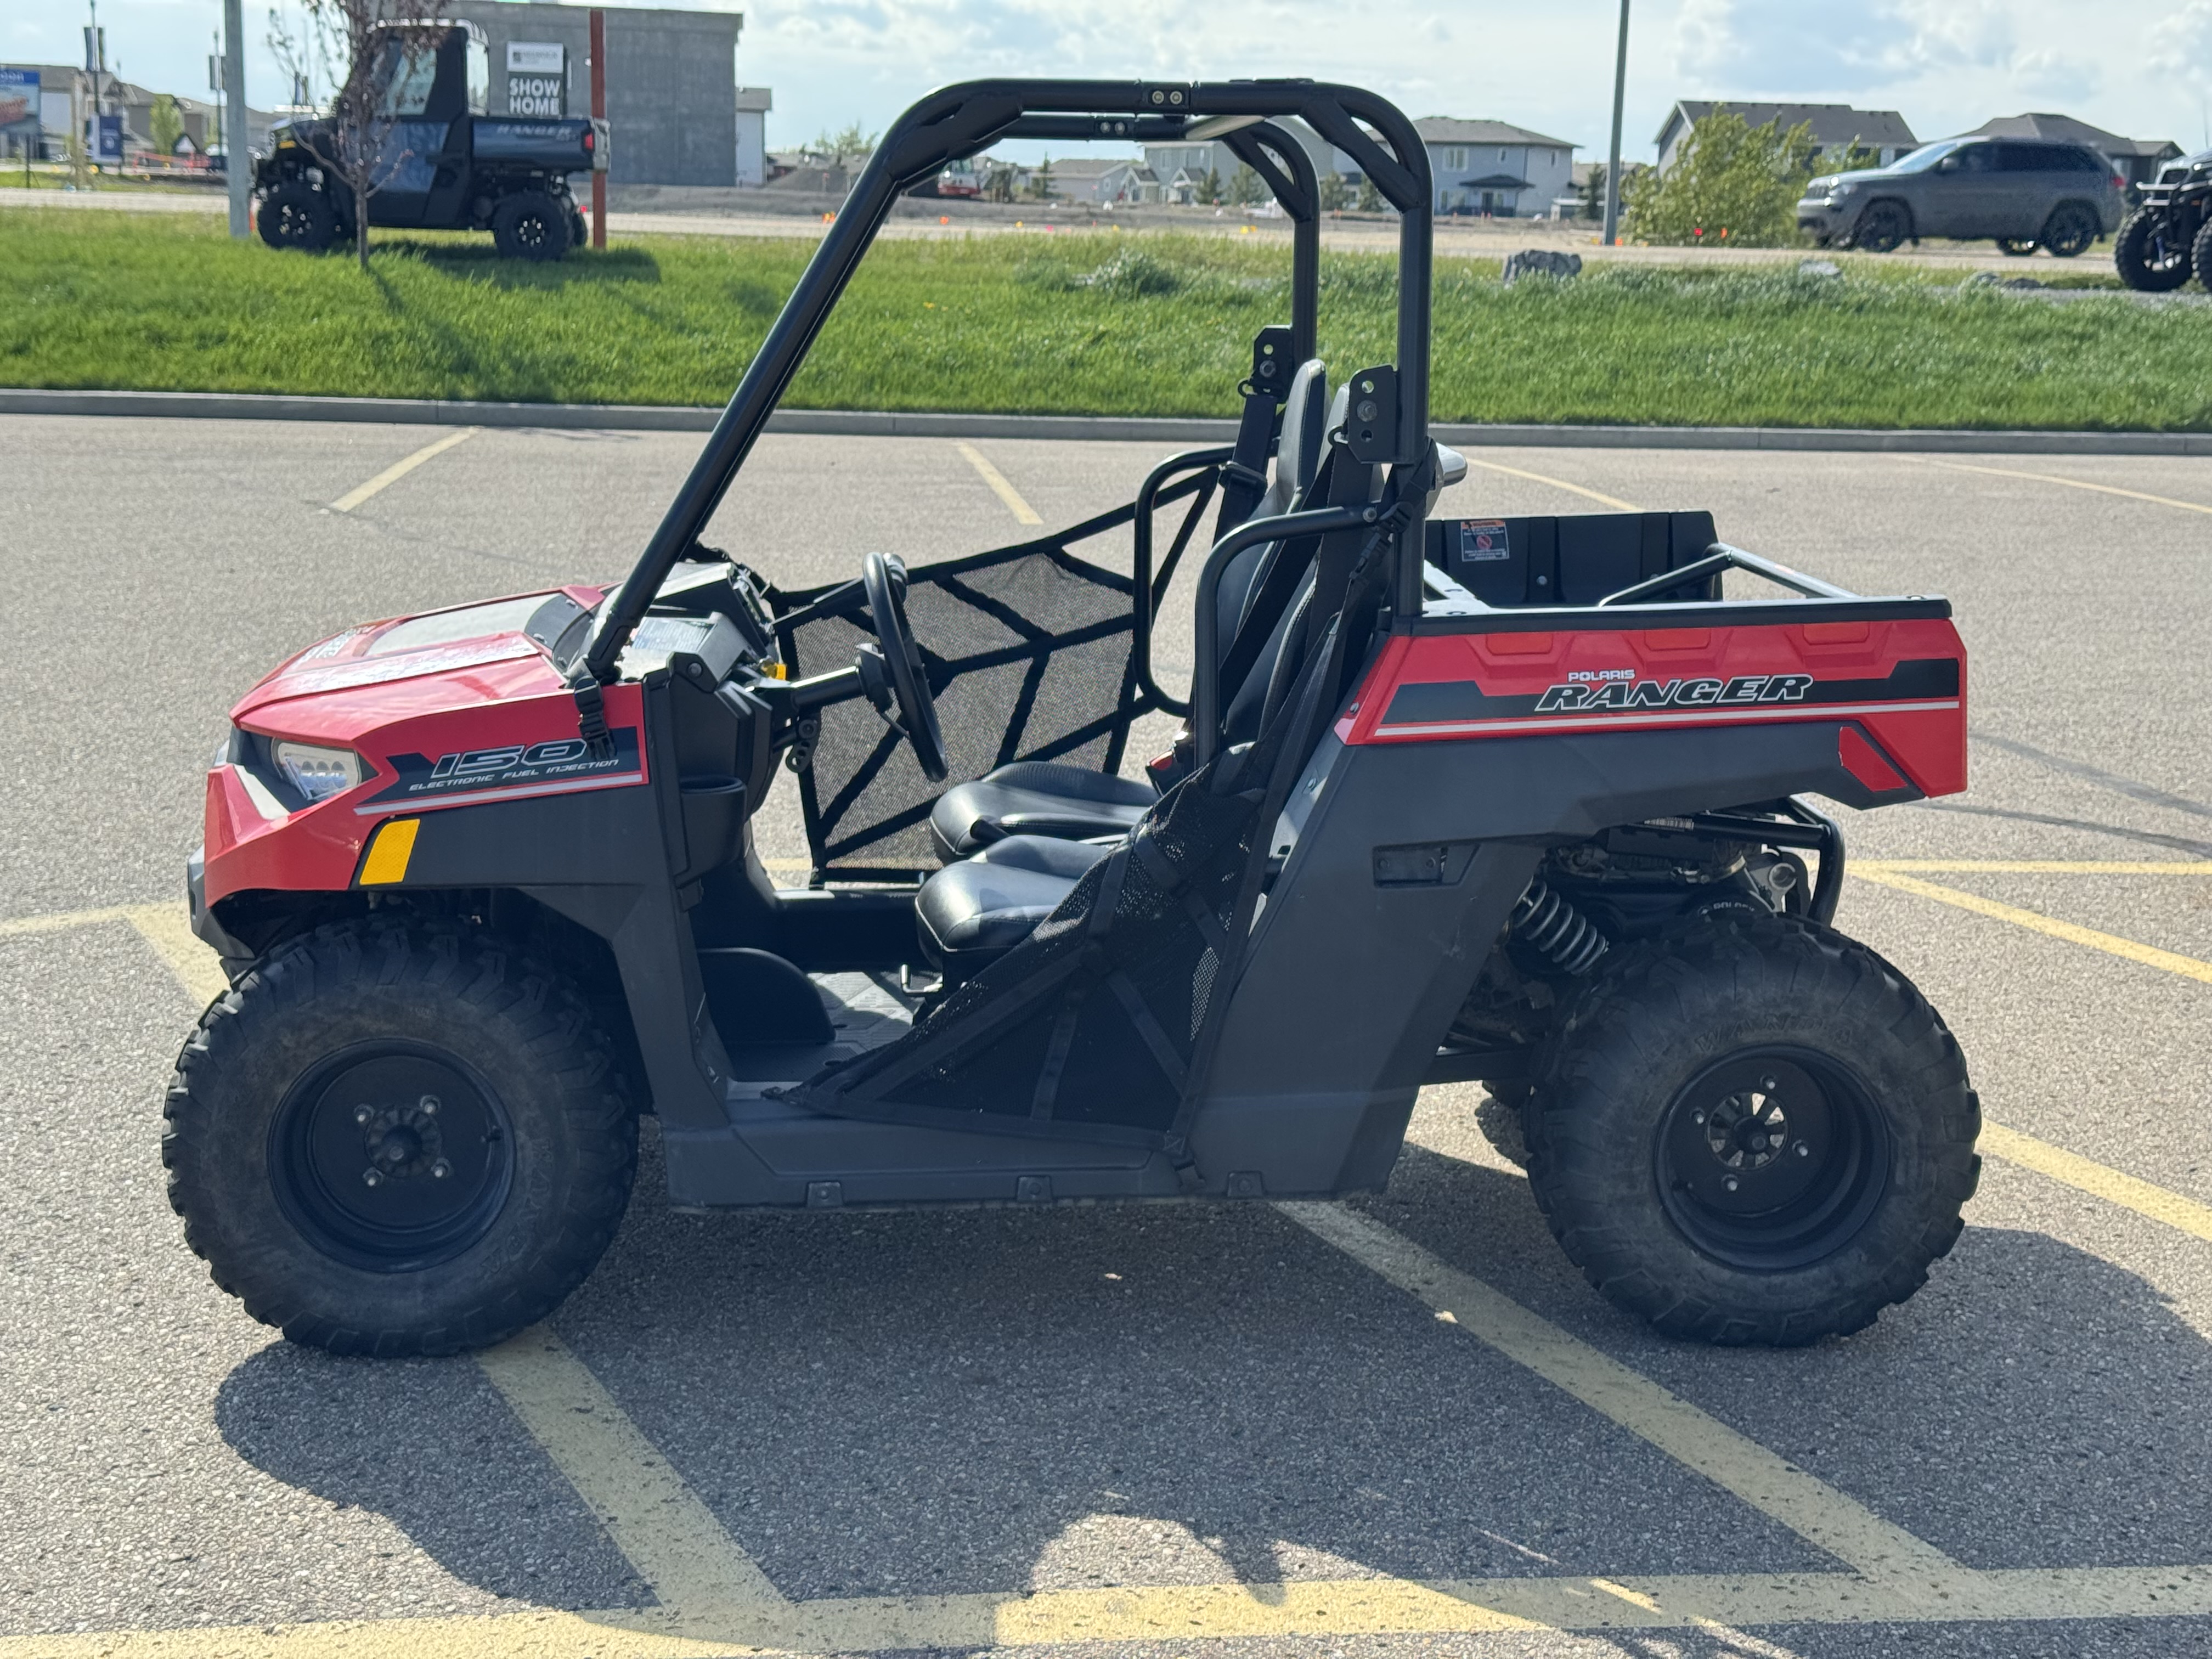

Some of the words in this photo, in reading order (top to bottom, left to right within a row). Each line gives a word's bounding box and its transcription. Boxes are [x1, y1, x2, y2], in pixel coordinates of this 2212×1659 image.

[510, 78, 561, 97] SHOW
[510, 96, 560, 115] HOME
[1568, 669, 1635, 681] POLARIS
[1534, 674, 1813, 712] RANGER
[431, 738, 588, 779] 150
[409, 774, 495, 792] ELECTRONIC
[502, 768, 539, 780] FUEL
[546, 759, 619, 774] INJECTION
